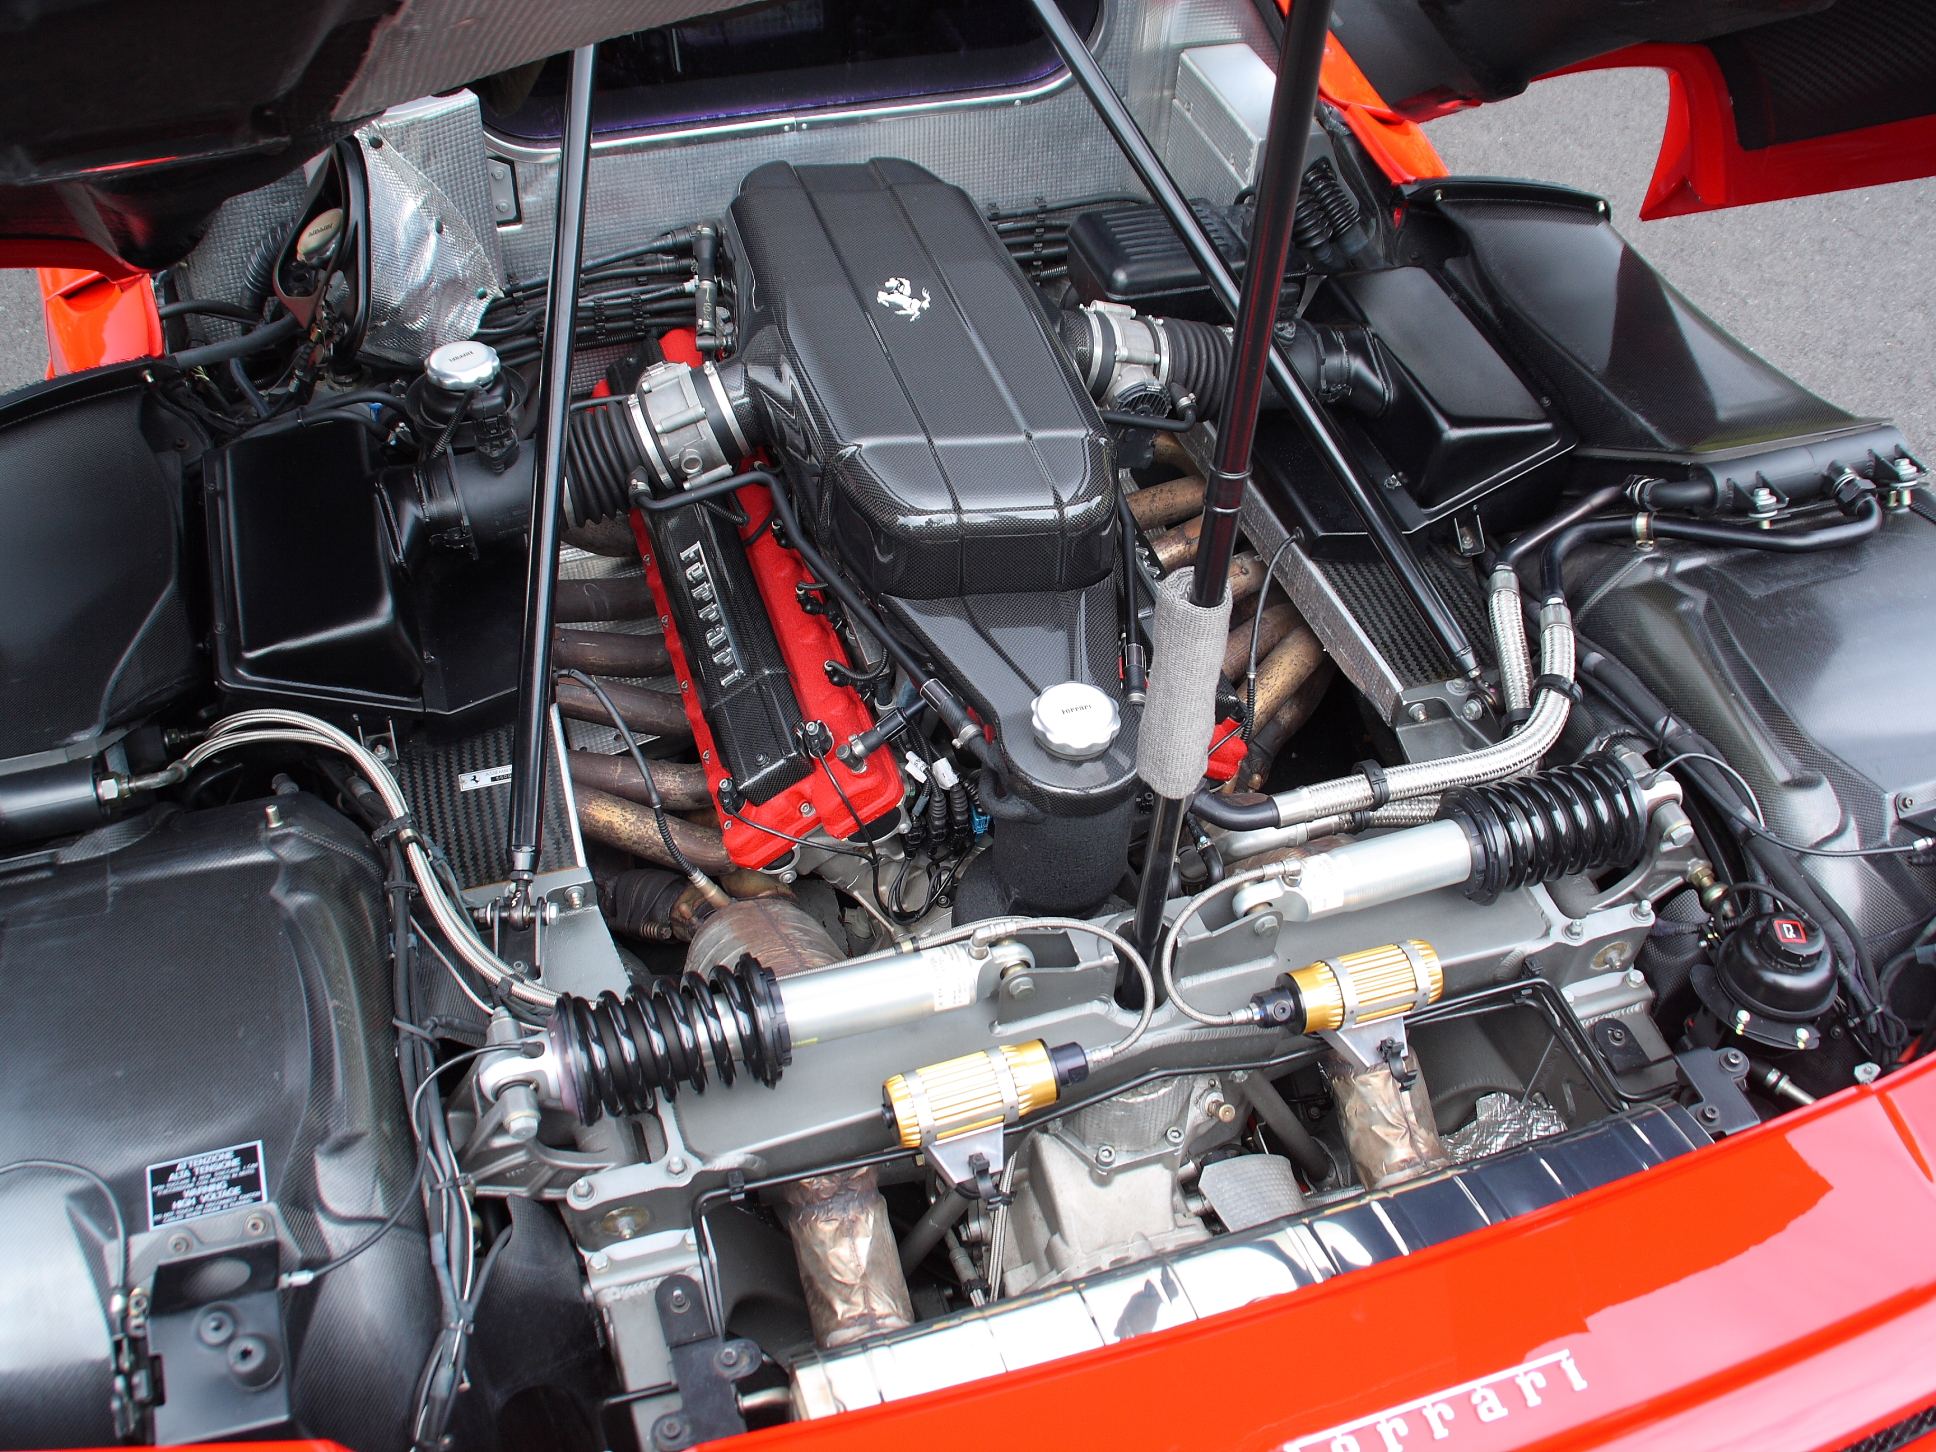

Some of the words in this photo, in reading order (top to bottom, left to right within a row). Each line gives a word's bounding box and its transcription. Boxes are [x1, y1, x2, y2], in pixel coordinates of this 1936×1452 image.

[680, 541, 746, 688] Ferrari
[1061, 704, 1092, 715] Ferrari
[168, 1169, 191, 1182] ALTA
[193, 1156, 241, 1176] TENSIONE
[176, 1150, 235, 1172] ATTENZIONE
[172, 1196, 197, 1210] HIGH
[199, 1185, 241, 1203] VOLTAGE
[183, 1181, 228, 1198] WARNING
